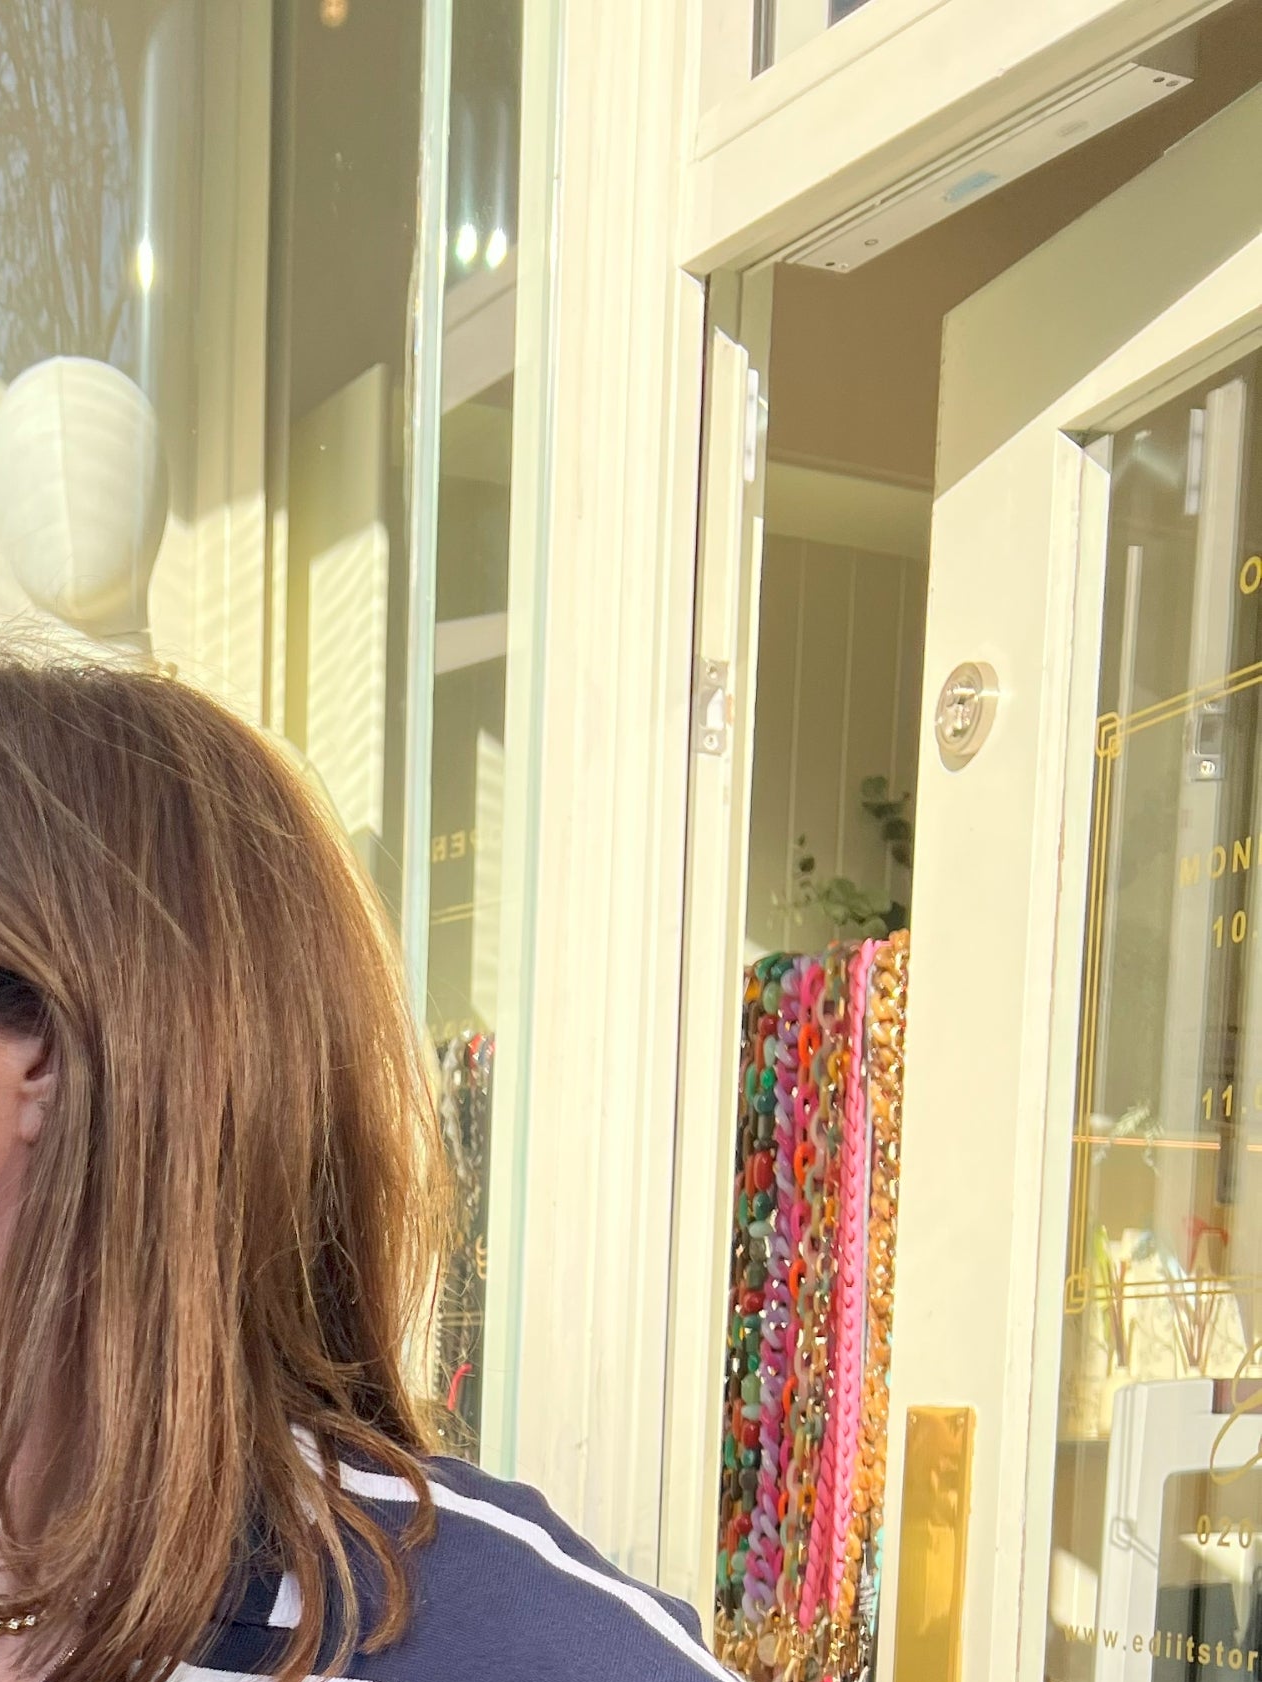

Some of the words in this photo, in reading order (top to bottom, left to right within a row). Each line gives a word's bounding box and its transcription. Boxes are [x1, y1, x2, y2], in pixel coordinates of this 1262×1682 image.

[1179, 834, 1262, 889] MON
[1195, 1514, 1252, 1550] 020
[1063, 1623, 1259, 1672] www.ediitstor
